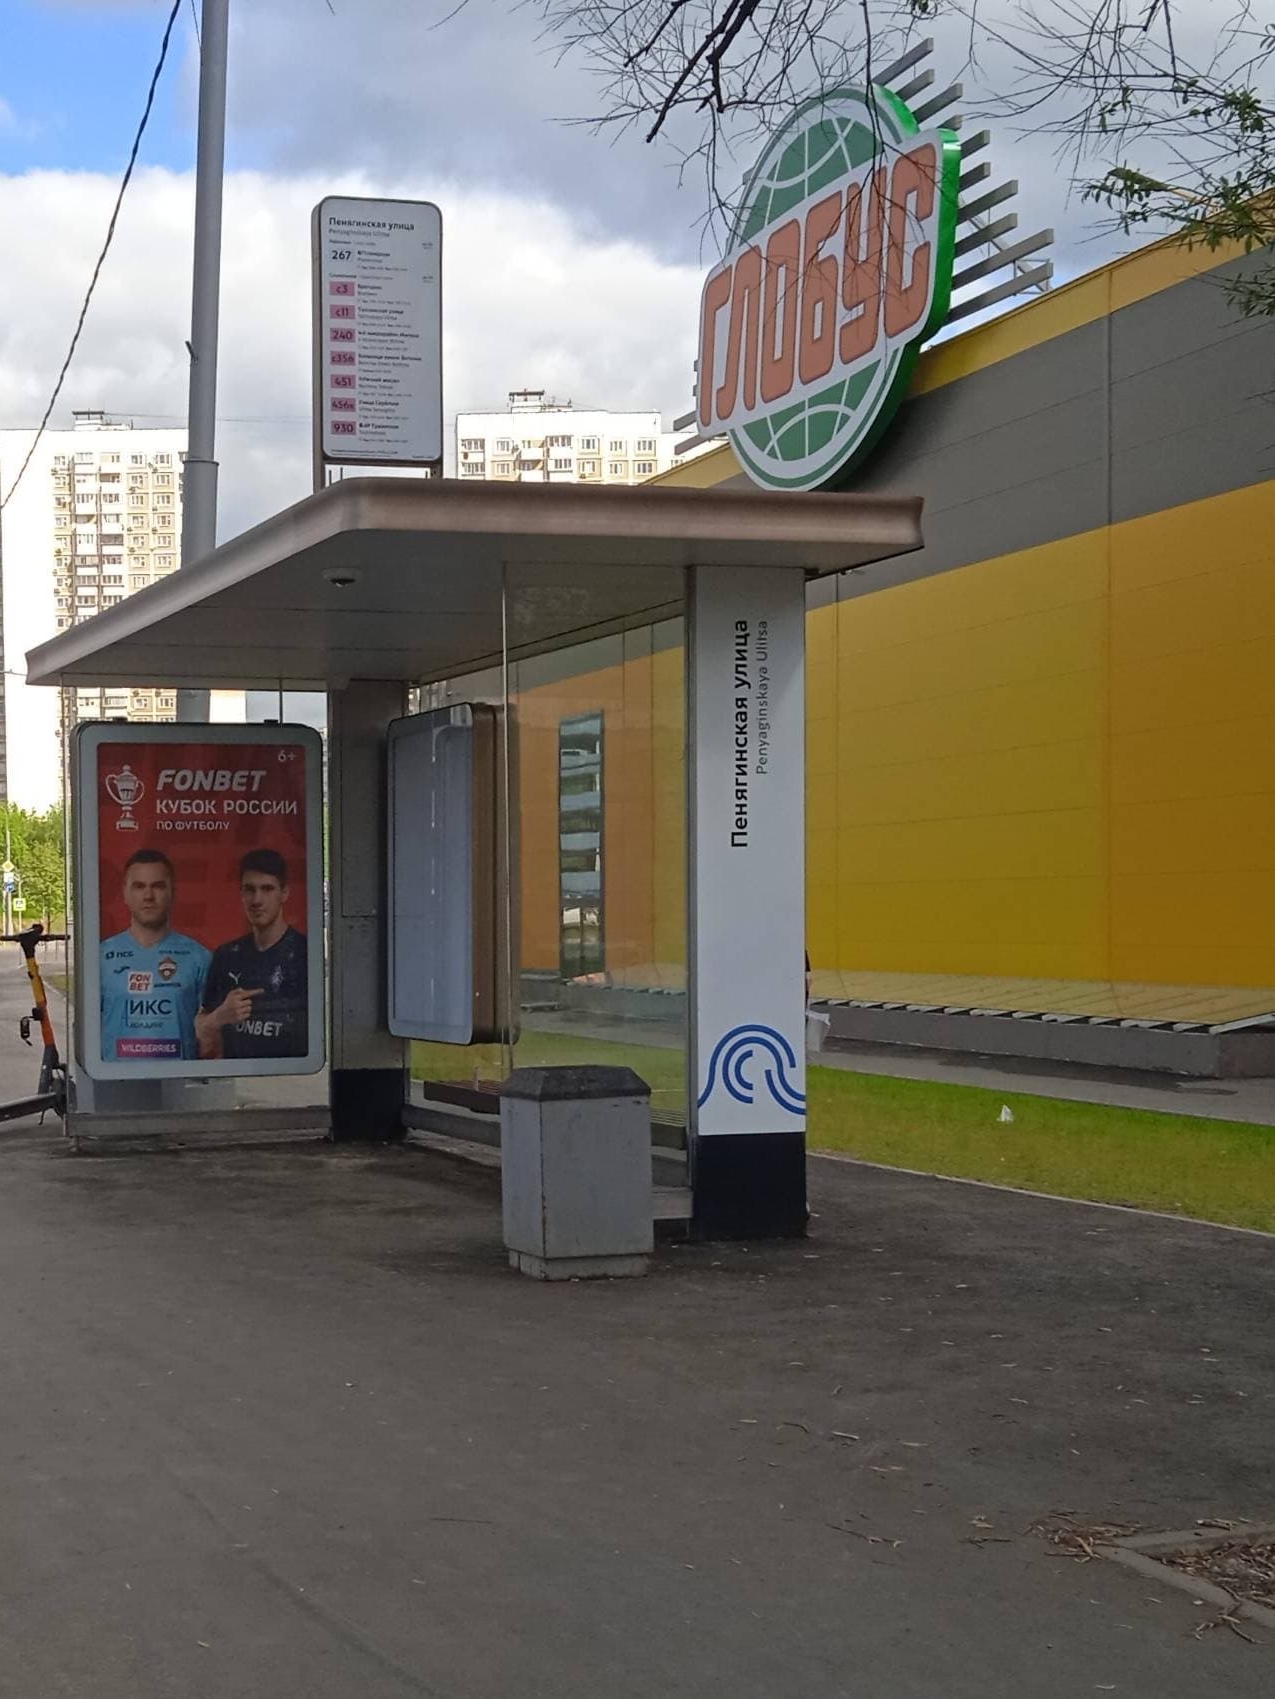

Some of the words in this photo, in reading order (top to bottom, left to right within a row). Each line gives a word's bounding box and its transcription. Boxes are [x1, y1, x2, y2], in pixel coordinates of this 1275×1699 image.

[328, 217, 386, 228] Пенягинская
[388, 222, 415, 231] улица
[332, 250, 351, 260] 267
[700, 142, 937, 427] ГЛОБУС
[333, 331, 353, 340] 240
[334, 377, 352, 387] 451
[333, 423, 354, 433] 930
[755, 620, 768, 662] Ulitsa
[734, 619, 751, 690] улица
[755, 666, 771, 775] Penyaginskaya
[278, 750, 297, 763] 6+
[731, 697, 749, 848] Пенягинская
[157, 769, 267, 792] FONBET
[156, 799, 216, 815] КУБОК
[223, 800, 298, 815] РОССИИ
[157, 821, 174, 831] ПО
[174, 820, 230, 831] ФУТБОЛУ
[129, 973, 151, 982] FON
[129, 982, 151, 991] BET
[130, 999, 173, 1015] ИКС
[235, 1020, 282, 1036] ONBET
[121, 1043, 177, 1053] WILDBERRIES
